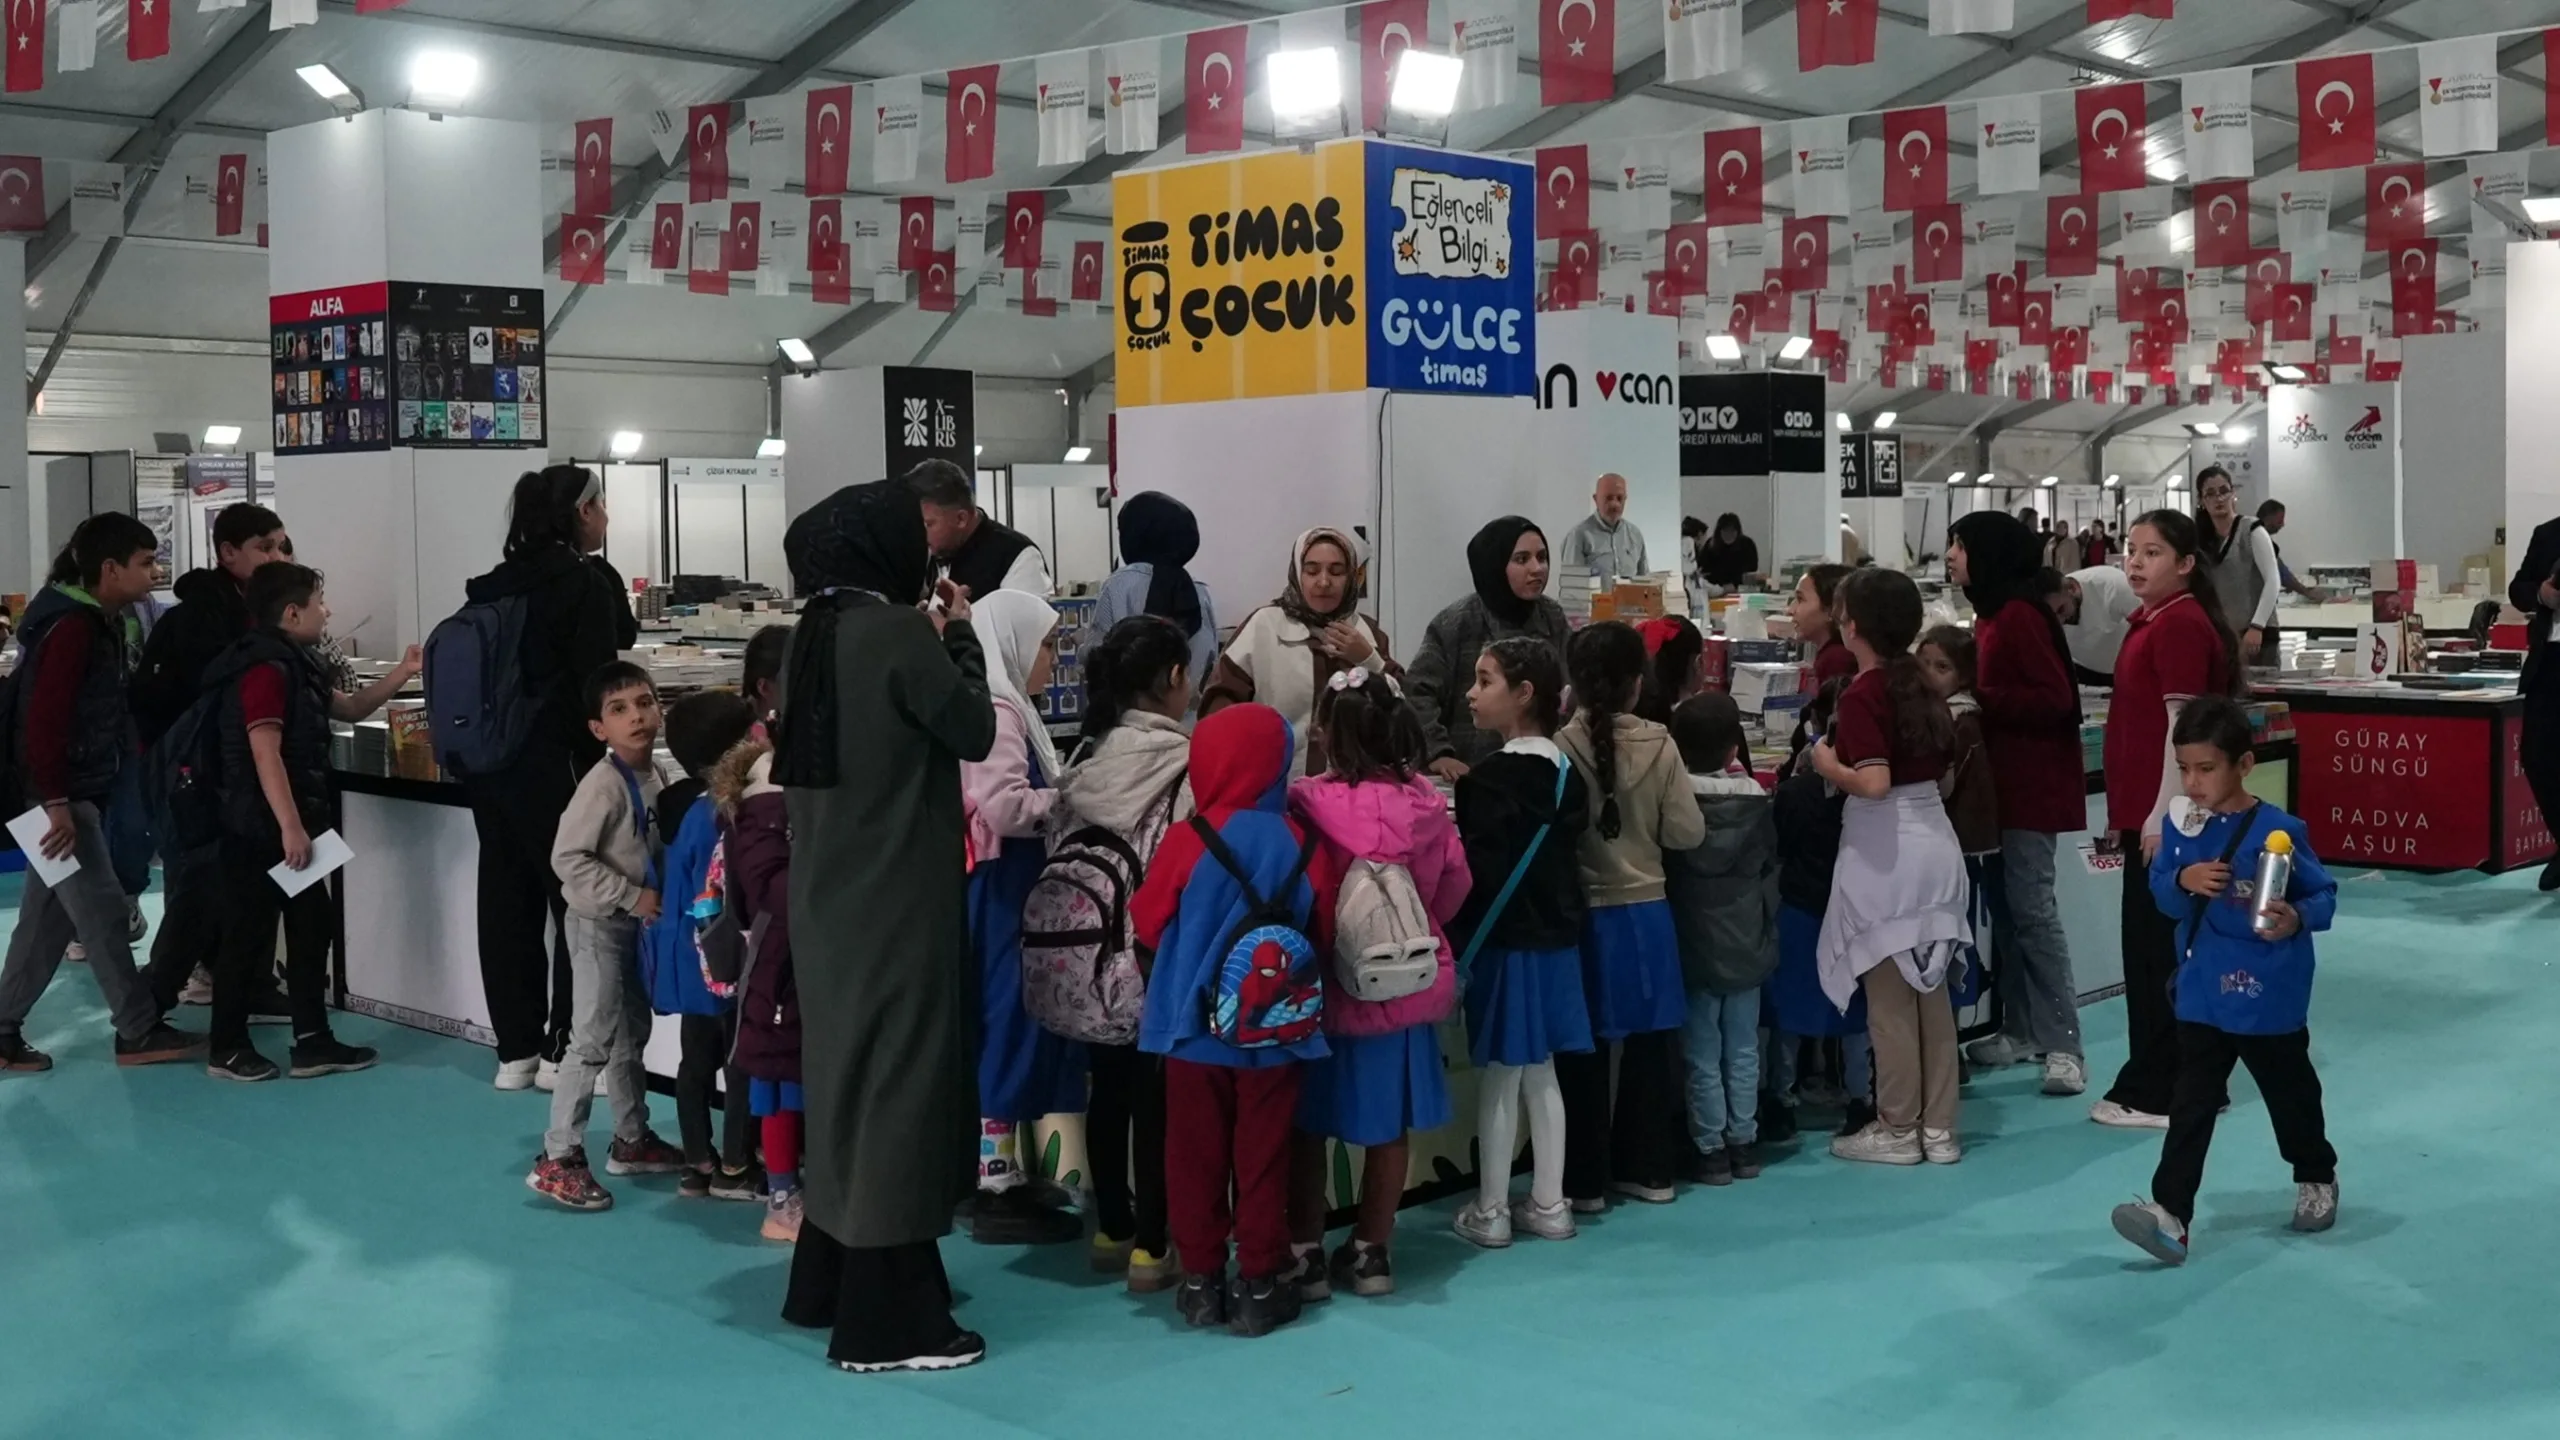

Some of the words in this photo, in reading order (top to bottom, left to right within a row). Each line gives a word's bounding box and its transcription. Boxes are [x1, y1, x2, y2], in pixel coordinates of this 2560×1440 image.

[1411, 180, 1493, 230] Eğlenceli
[1439, 225, 1488, 273] Bilgi
[310, 296, 344, 317] ALFA
[1180, 274, 1356, 353] ÇOCUK
[1381, 298, 1521, 354] GÜLCE
[1127, 331, 1171, 353] ÇOCUK
[1420, 355, 1488, 388] timaş
[1536, 363, 1578, 409] n
[1619, 372, 1673, 405] can
[1710, 432, 1763, 445] YAYINLARI
[2344, 430, 2383, 442] erdem
[2335, 728, 2428, 751] GÜRAY
[2332, 754, 2428, 777] SÜNGÜ
[2331, 807, 2429, 829] RADVA
[2341, 834, 2417, 855] AŞUR
